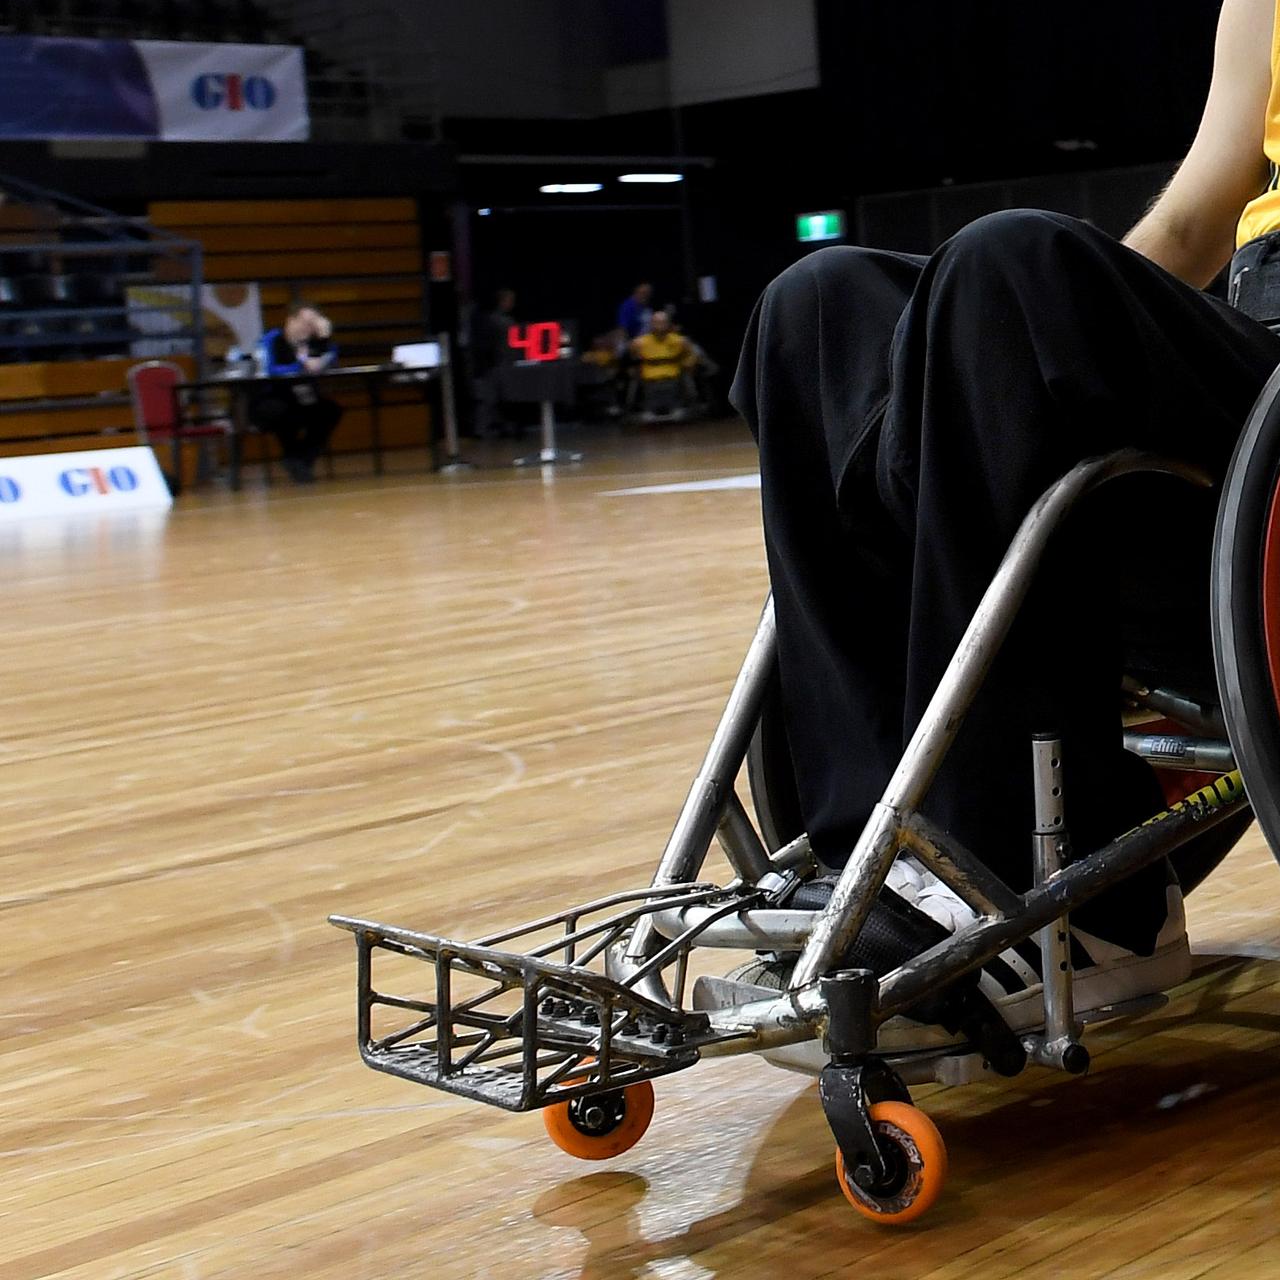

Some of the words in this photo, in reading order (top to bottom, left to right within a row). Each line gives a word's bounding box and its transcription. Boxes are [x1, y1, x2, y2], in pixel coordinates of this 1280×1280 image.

[190, 72, 276, 112] GIO
[508, 322, 560, 361] 40
[58, 466, 139, 496] GIO
